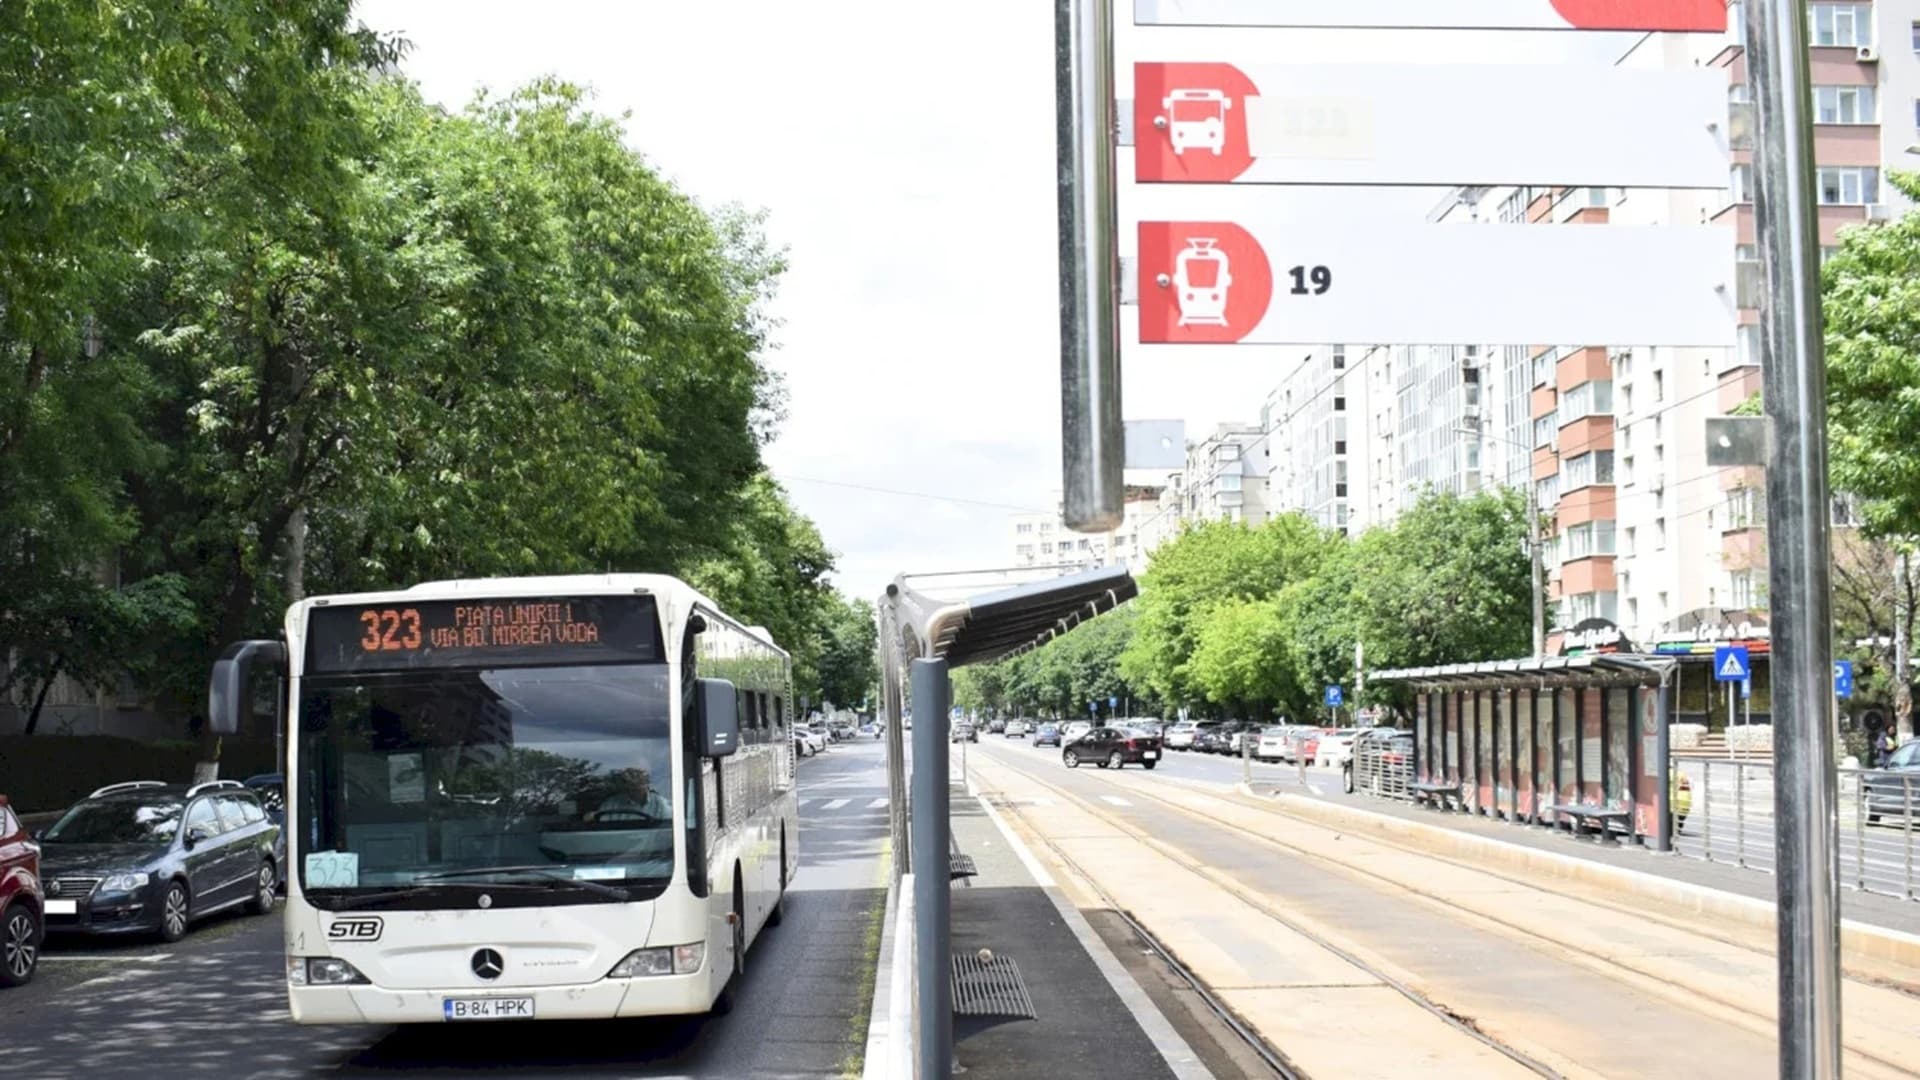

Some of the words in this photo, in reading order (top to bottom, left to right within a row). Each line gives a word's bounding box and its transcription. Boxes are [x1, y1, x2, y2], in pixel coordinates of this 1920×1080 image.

[1289, 265, 1331, 295] 19
[455, 606, 504, 625] PIATA
[508, 604, 560, 624] UNIRII
[361, 609, 421, 650] 323
[431, 628, 459, 648] VIA
[492, 624, 551, 645] MIRCEA
[556, 622, 598, 643] VODA
[309, 857, 355, 888] 323
[328, 921, 378, 937] STB
[455, 1002, 467, 1016] B
[472, 1002, 489, 1015] 84
[496, 1000, 527, 1015] HPK
